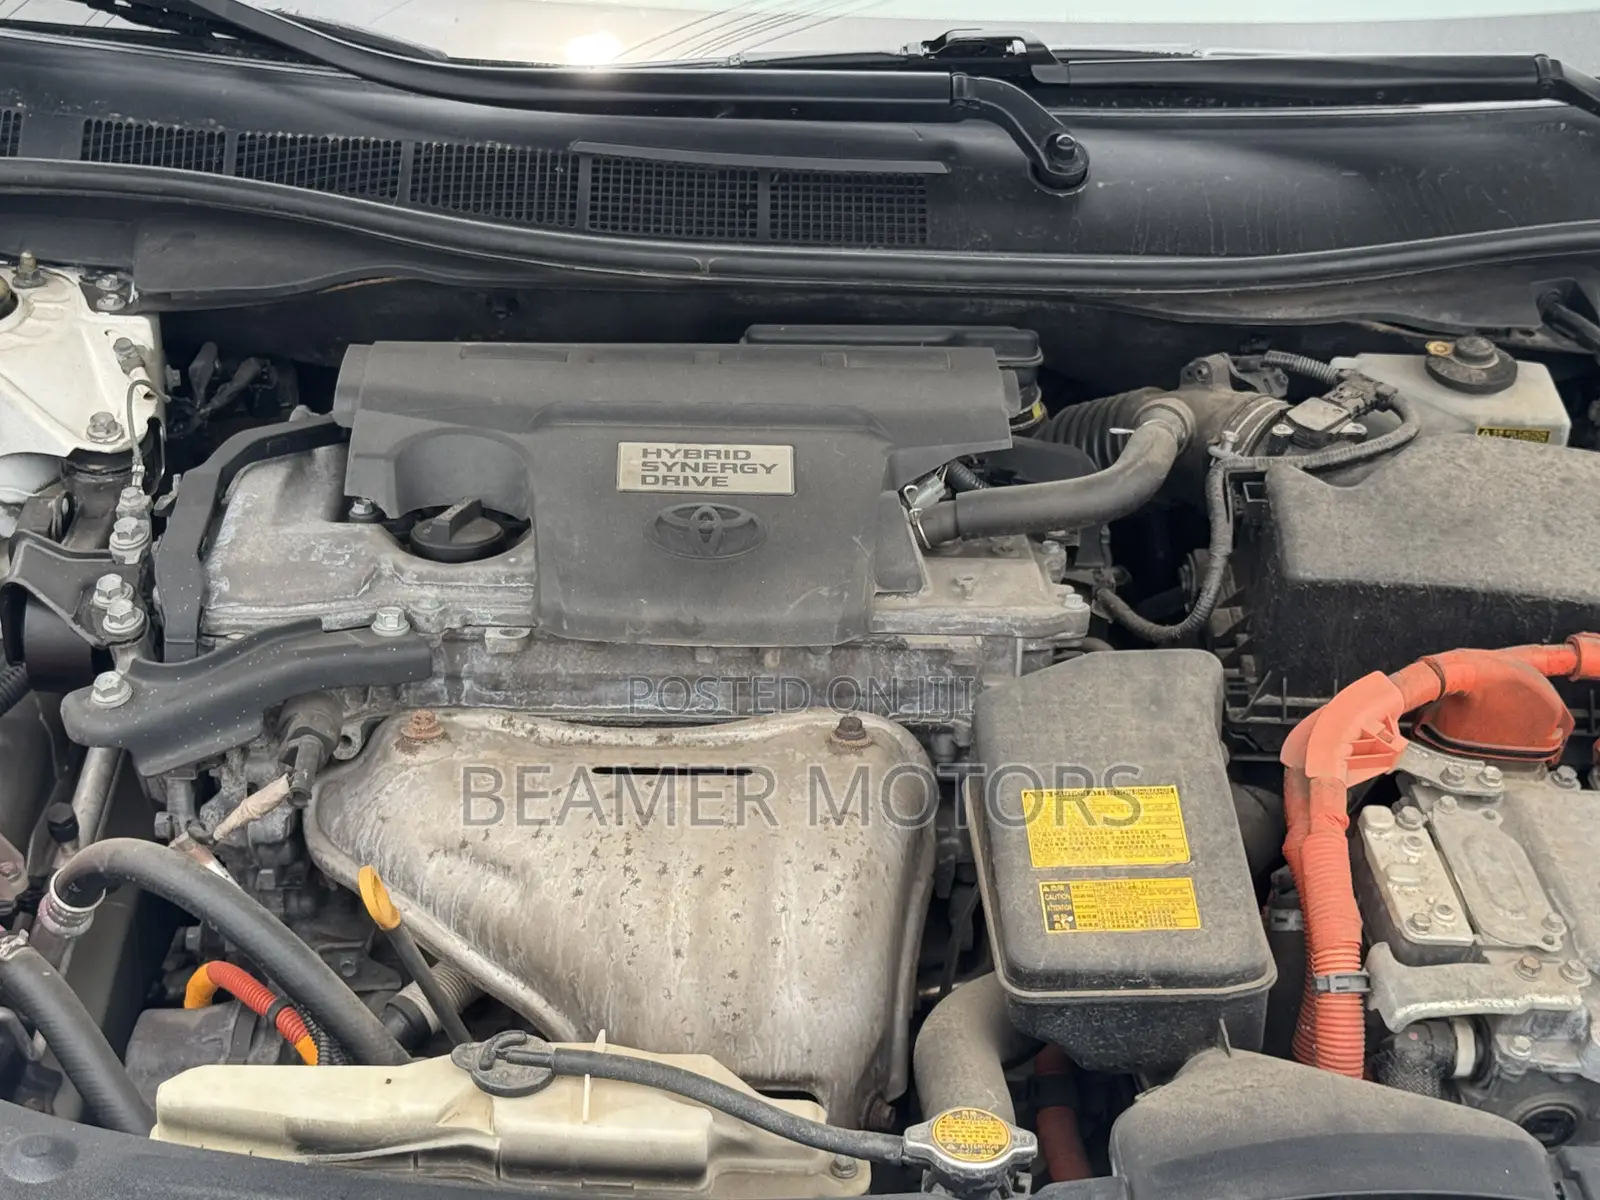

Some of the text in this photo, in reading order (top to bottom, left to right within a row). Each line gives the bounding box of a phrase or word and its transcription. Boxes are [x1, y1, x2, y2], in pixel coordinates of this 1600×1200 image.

[641, 448, 752, 461] HYBRID
[640, 461, 780, 475] SYNERGY
[640, 474, 729, 487] DRIVE
[1044, 892, 1071, 901] CAUTION
